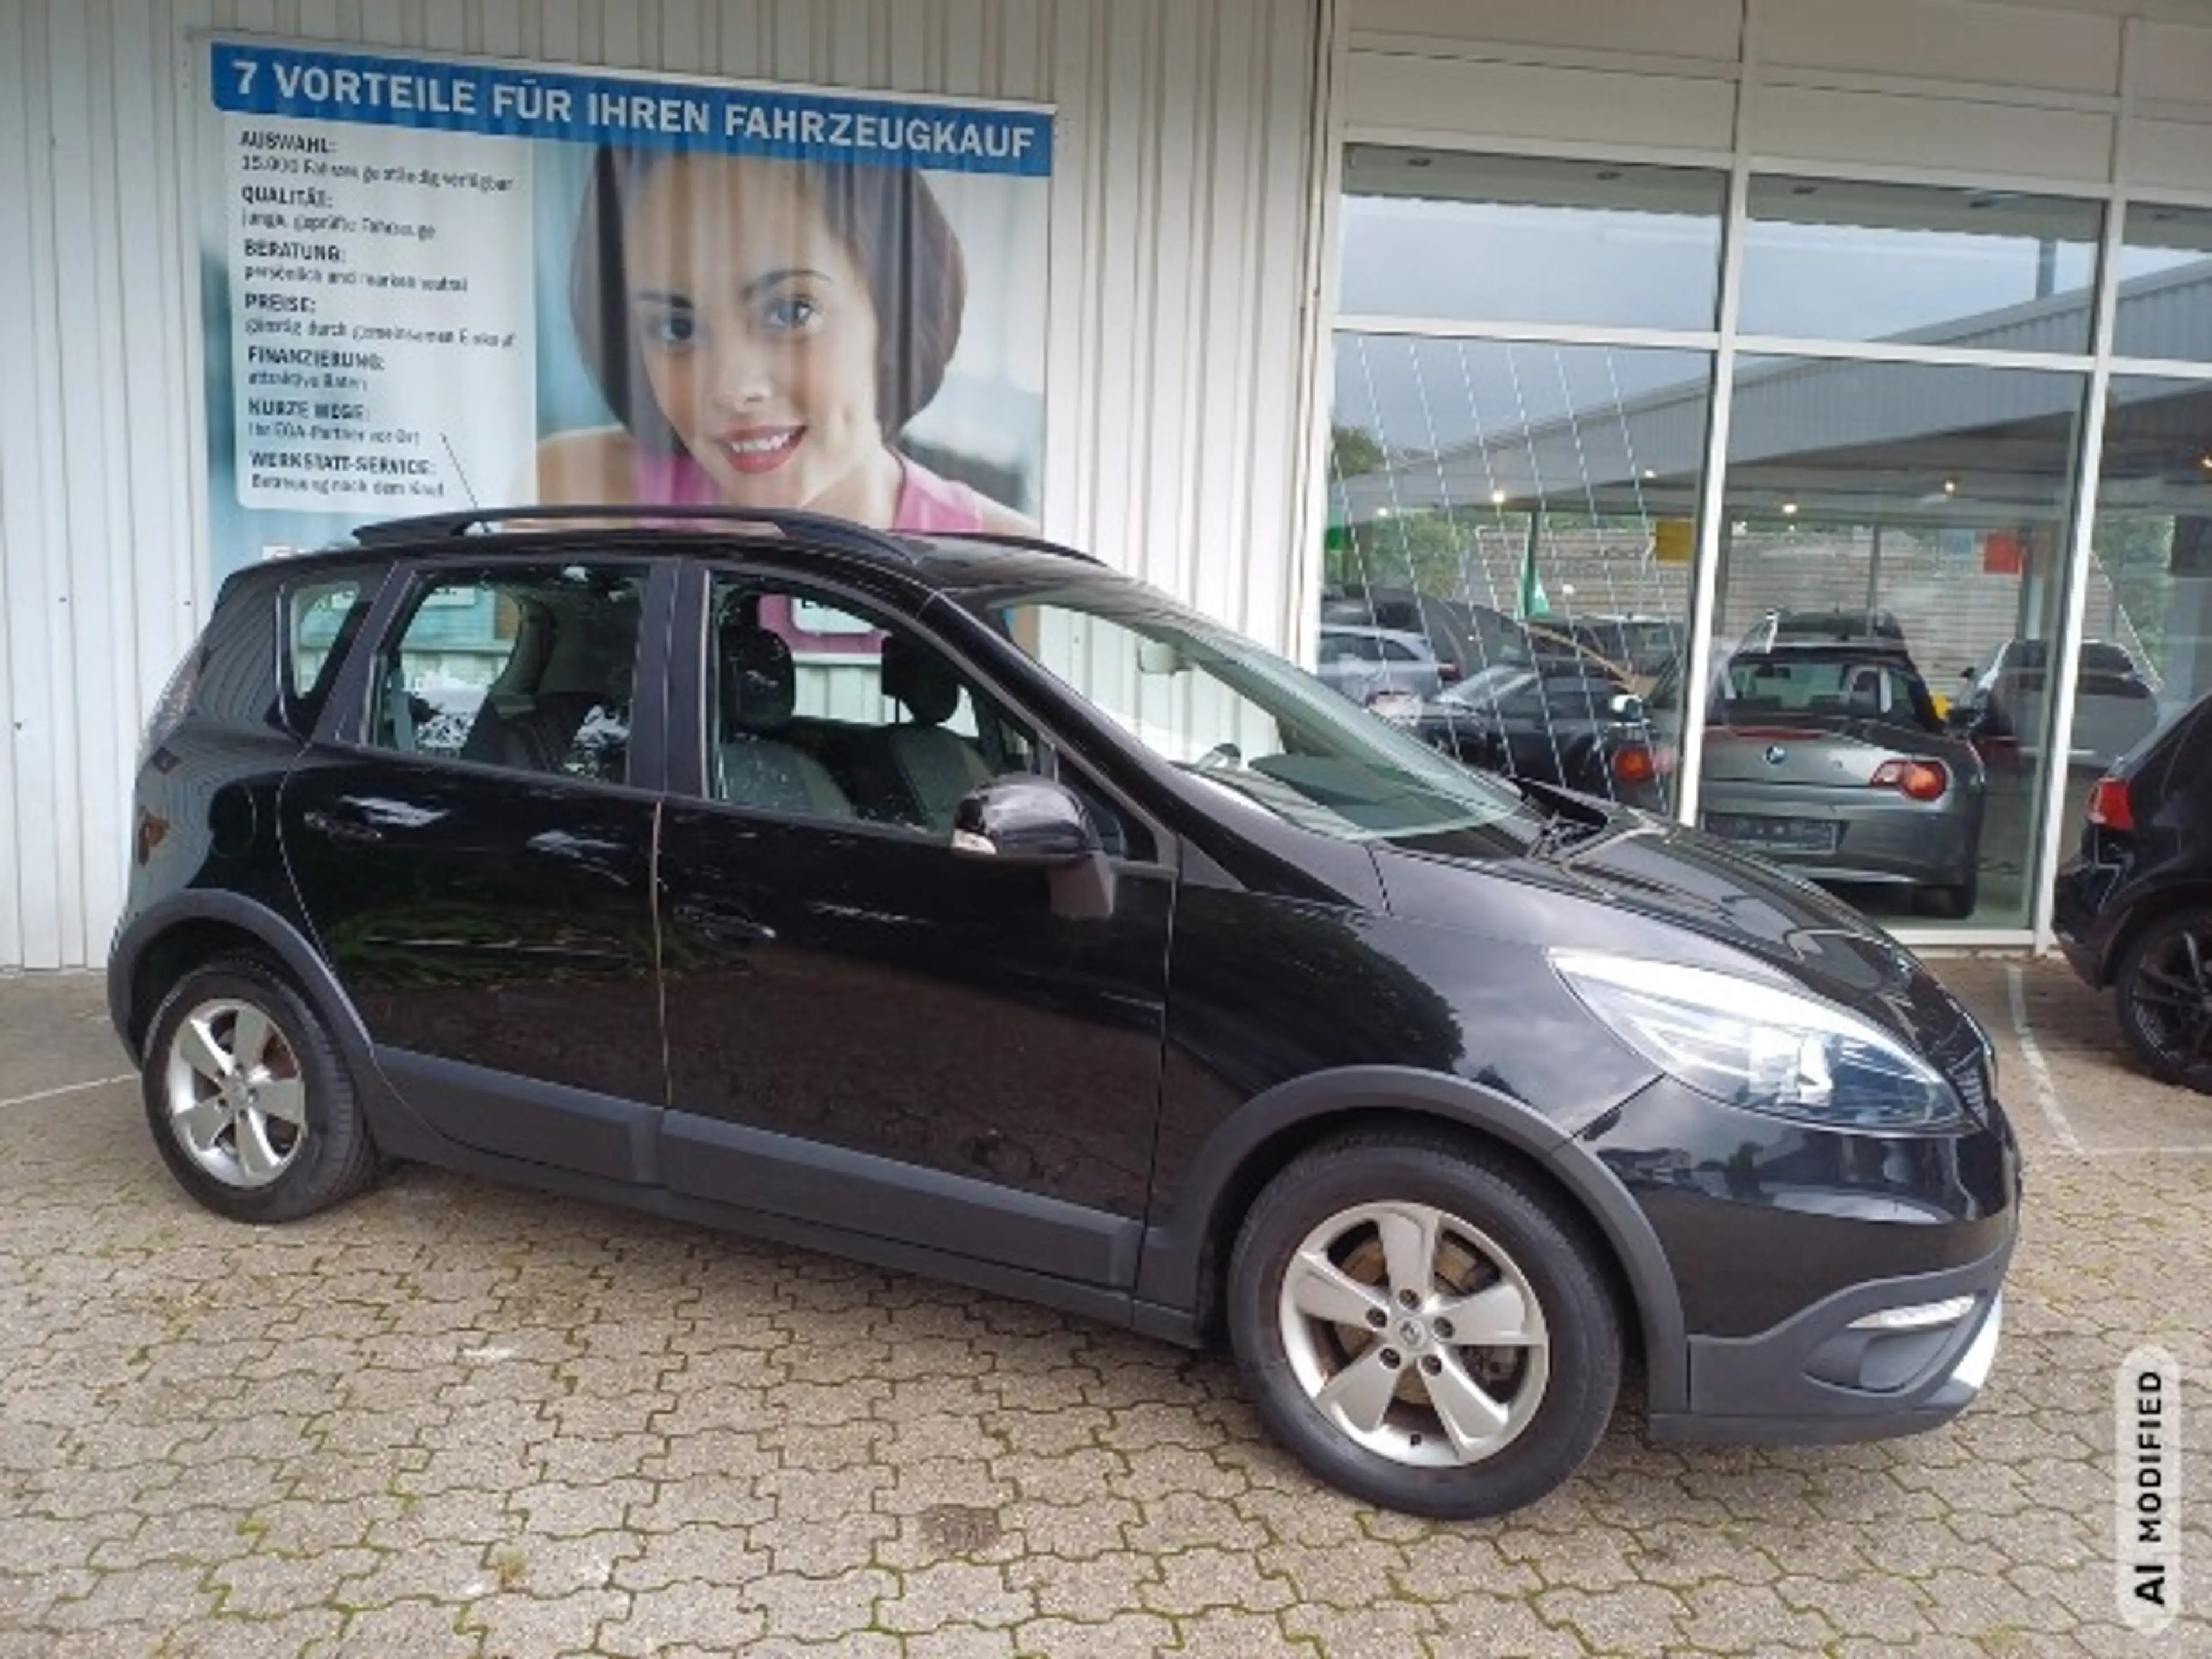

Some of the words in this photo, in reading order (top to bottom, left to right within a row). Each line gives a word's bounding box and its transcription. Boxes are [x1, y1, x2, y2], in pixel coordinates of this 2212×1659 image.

[233, 60, 259, 95] 7
[273, 63, 477, 114] VORTEILE
[493, 78, 572, 123] FÜR
[586, 93, 709, 134] IHREN
[725, 105, 1035, 158] FAHRZEUGKAUF
[244, 292, 316, 313] PREISE:
